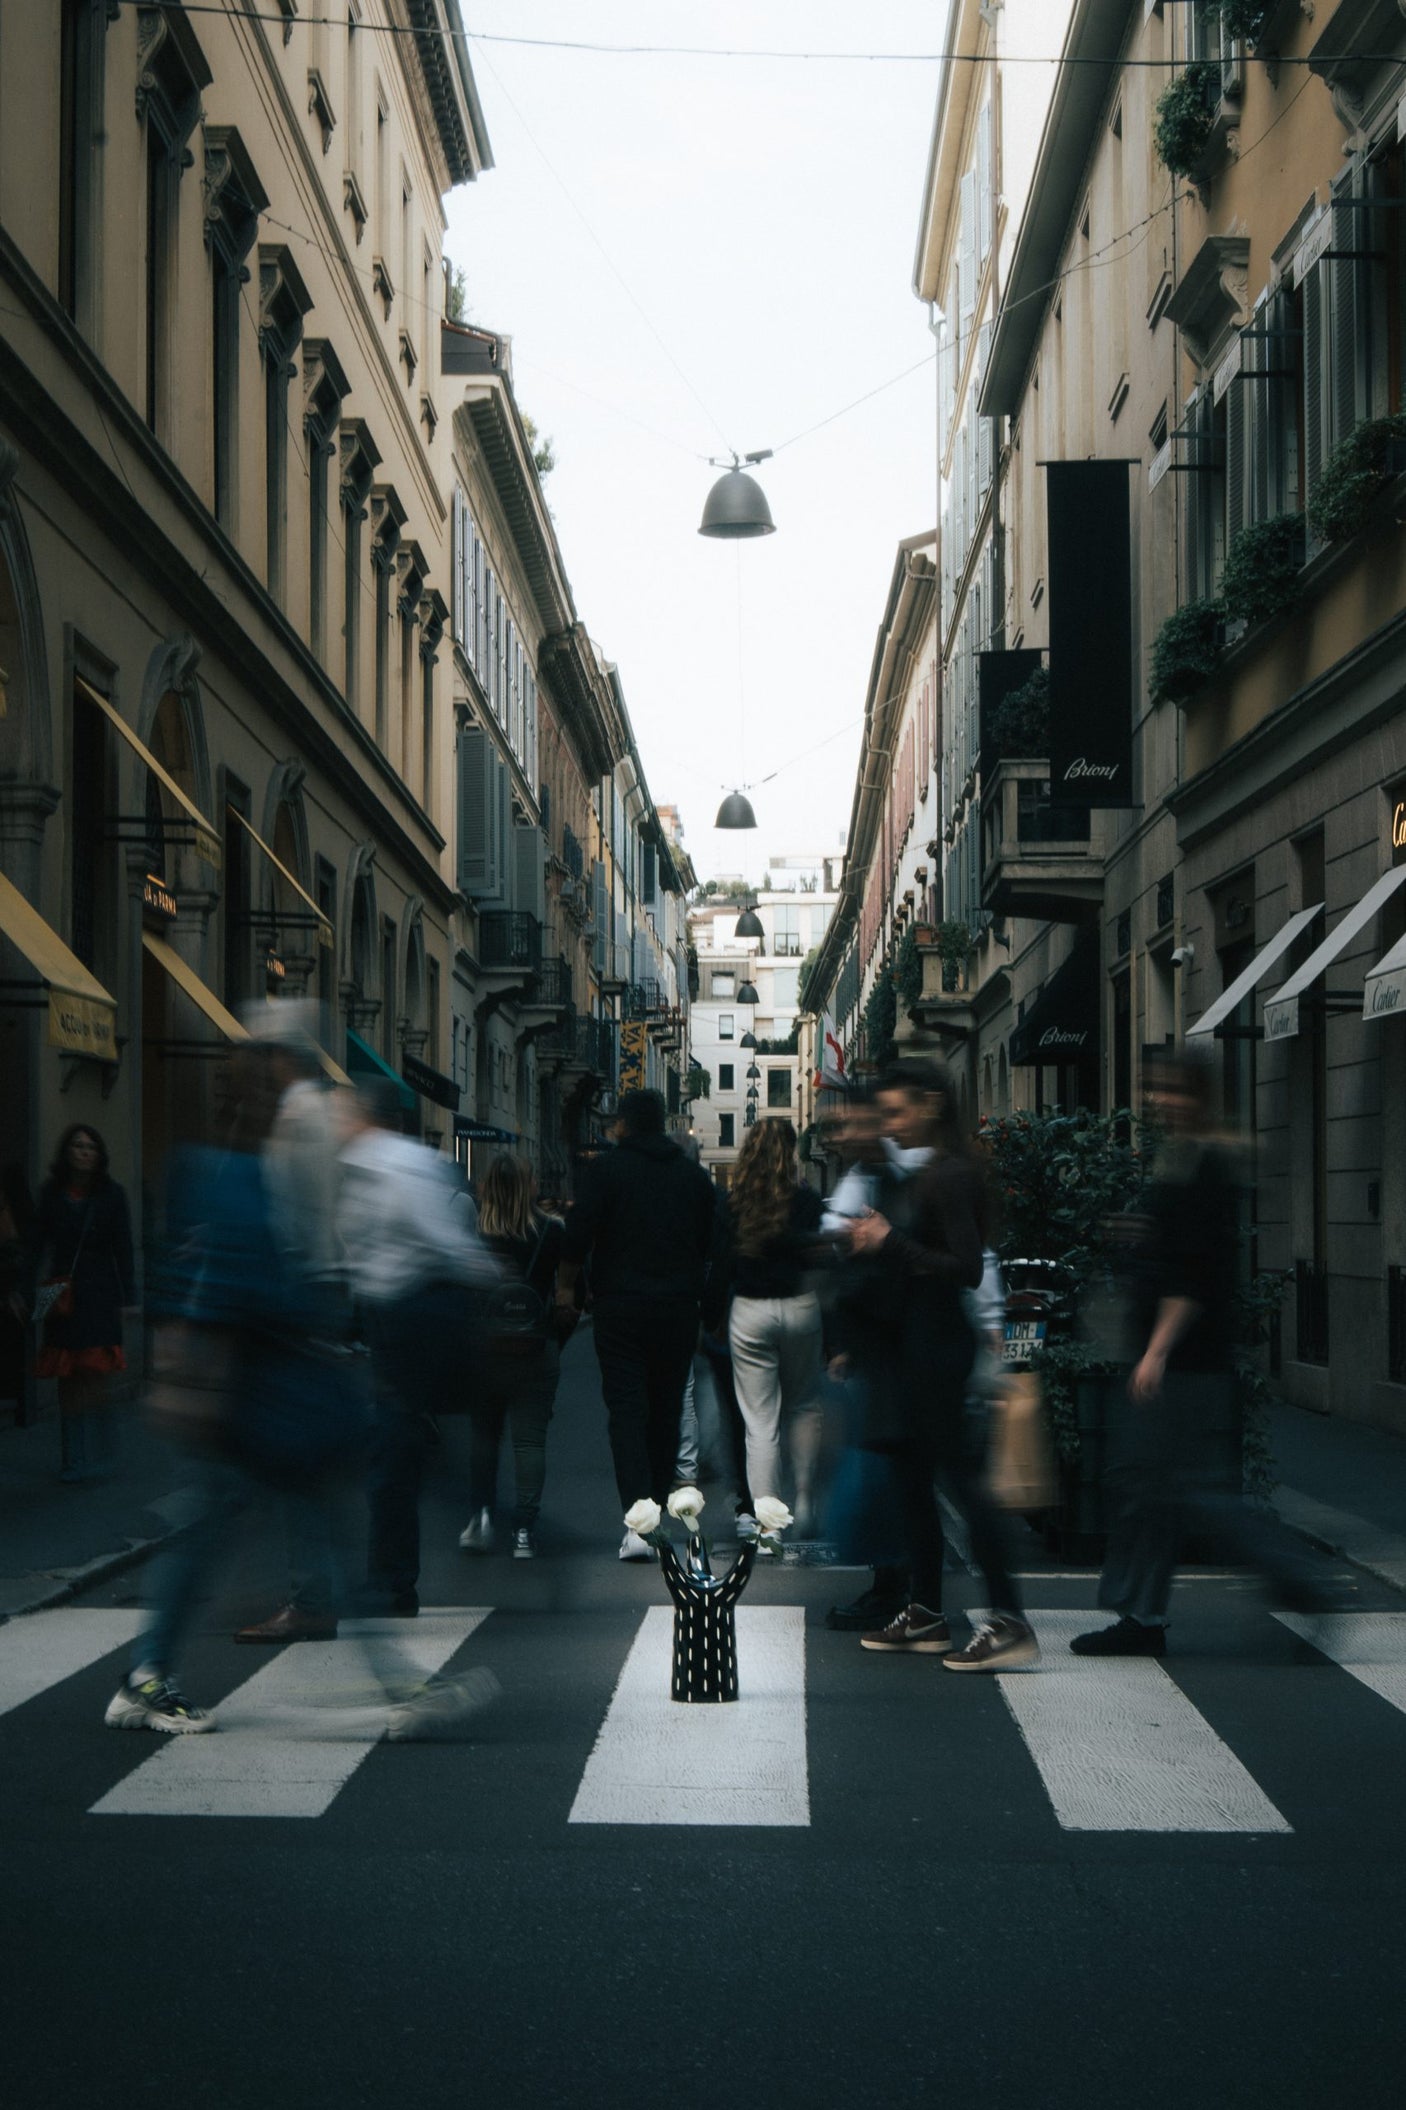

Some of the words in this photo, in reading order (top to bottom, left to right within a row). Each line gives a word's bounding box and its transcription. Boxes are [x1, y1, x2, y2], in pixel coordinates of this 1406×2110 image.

[1063, 757, 1119, 781] Brioni
[1373, 979, 1401, 1012] Cartier
[1038, 1026, 1088, 1046] Brioni
